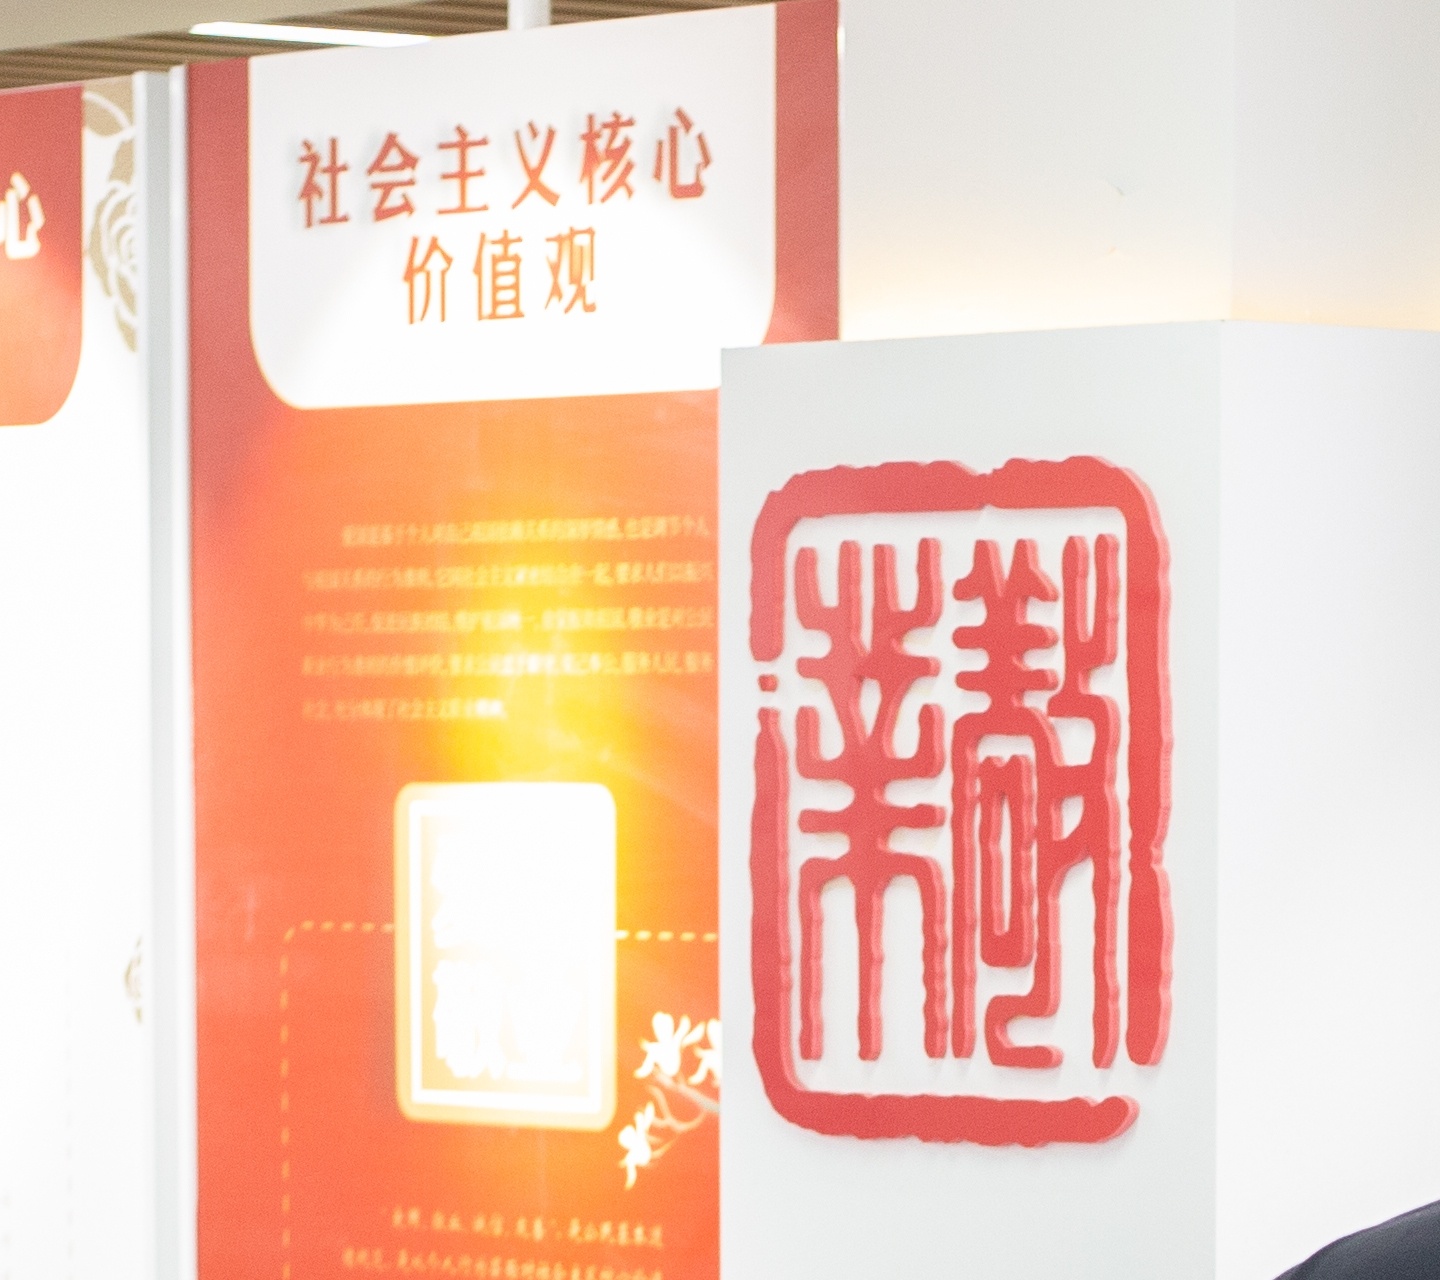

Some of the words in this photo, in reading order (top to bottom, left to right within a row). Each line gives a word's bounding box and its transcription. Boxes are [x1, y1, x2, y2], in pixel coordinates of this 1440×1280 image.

[296, 105, 711, 230] 社会主义核心
[402, 225, 598, 326] 价值观
